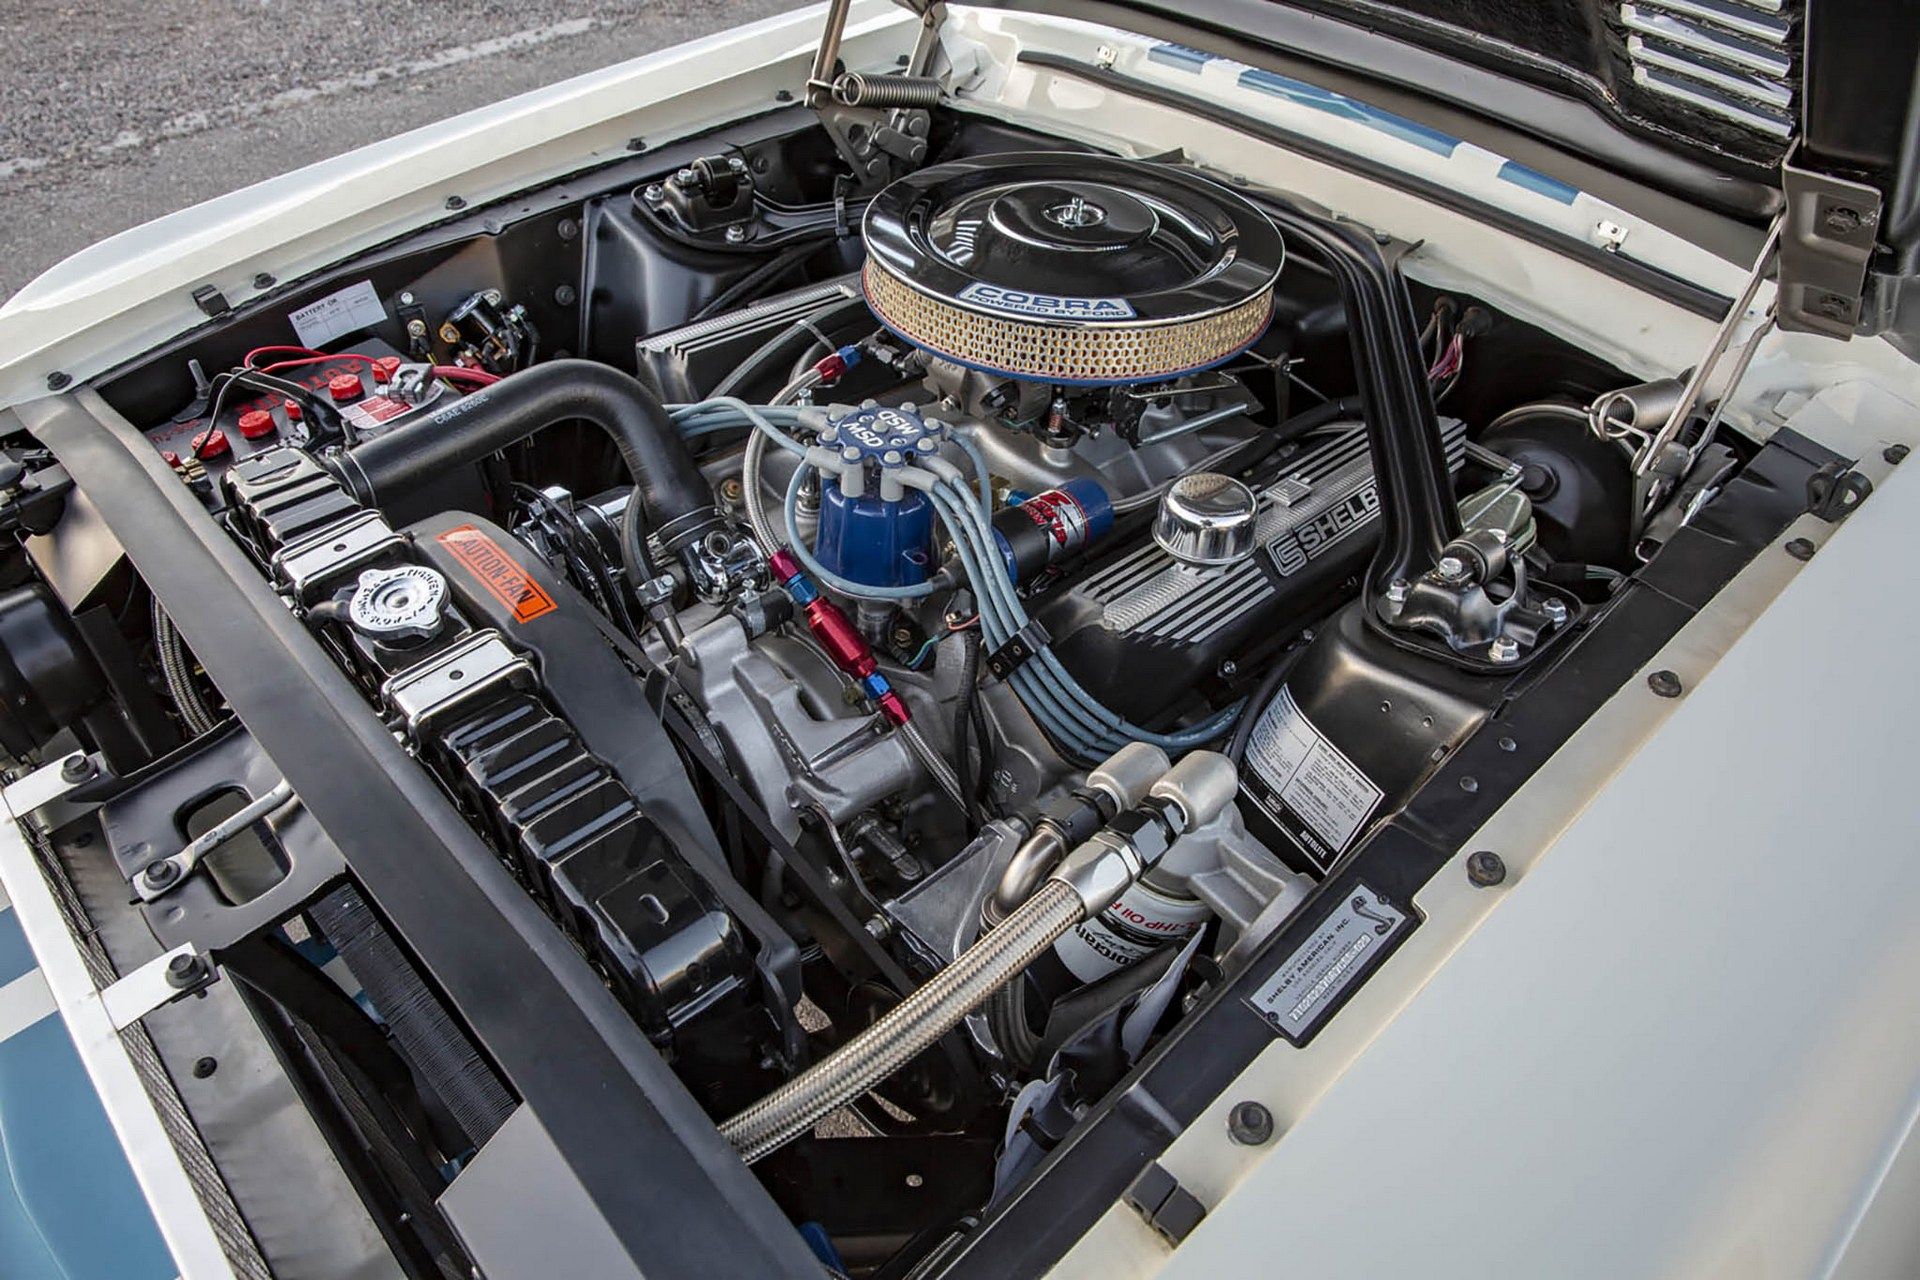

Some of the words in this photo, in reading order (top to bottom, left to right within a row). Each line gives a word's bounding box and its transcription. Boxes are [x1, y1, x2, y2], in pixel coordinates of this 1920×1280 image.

[968, 293, 1048, 313] POWERED
[1054, 308, 1080, 316] BY
[975, 286, 1119, 310] COBRA
[295, 304, 325, 321] BATTERY
[842, 422, 884, 447] MSD
[878, 410, 920, 435] MSD
[1297, 484, 1380, 551] SHELB
[1121, 908, 1145, 924] Oil
[1075, 924, 1137, 966] orcraft
[1266, 972, 1297, 1004] SHELBY
[1296, 933, 1335, 973] AMERICAN
[1334, 916, 1351, 933] INC.
